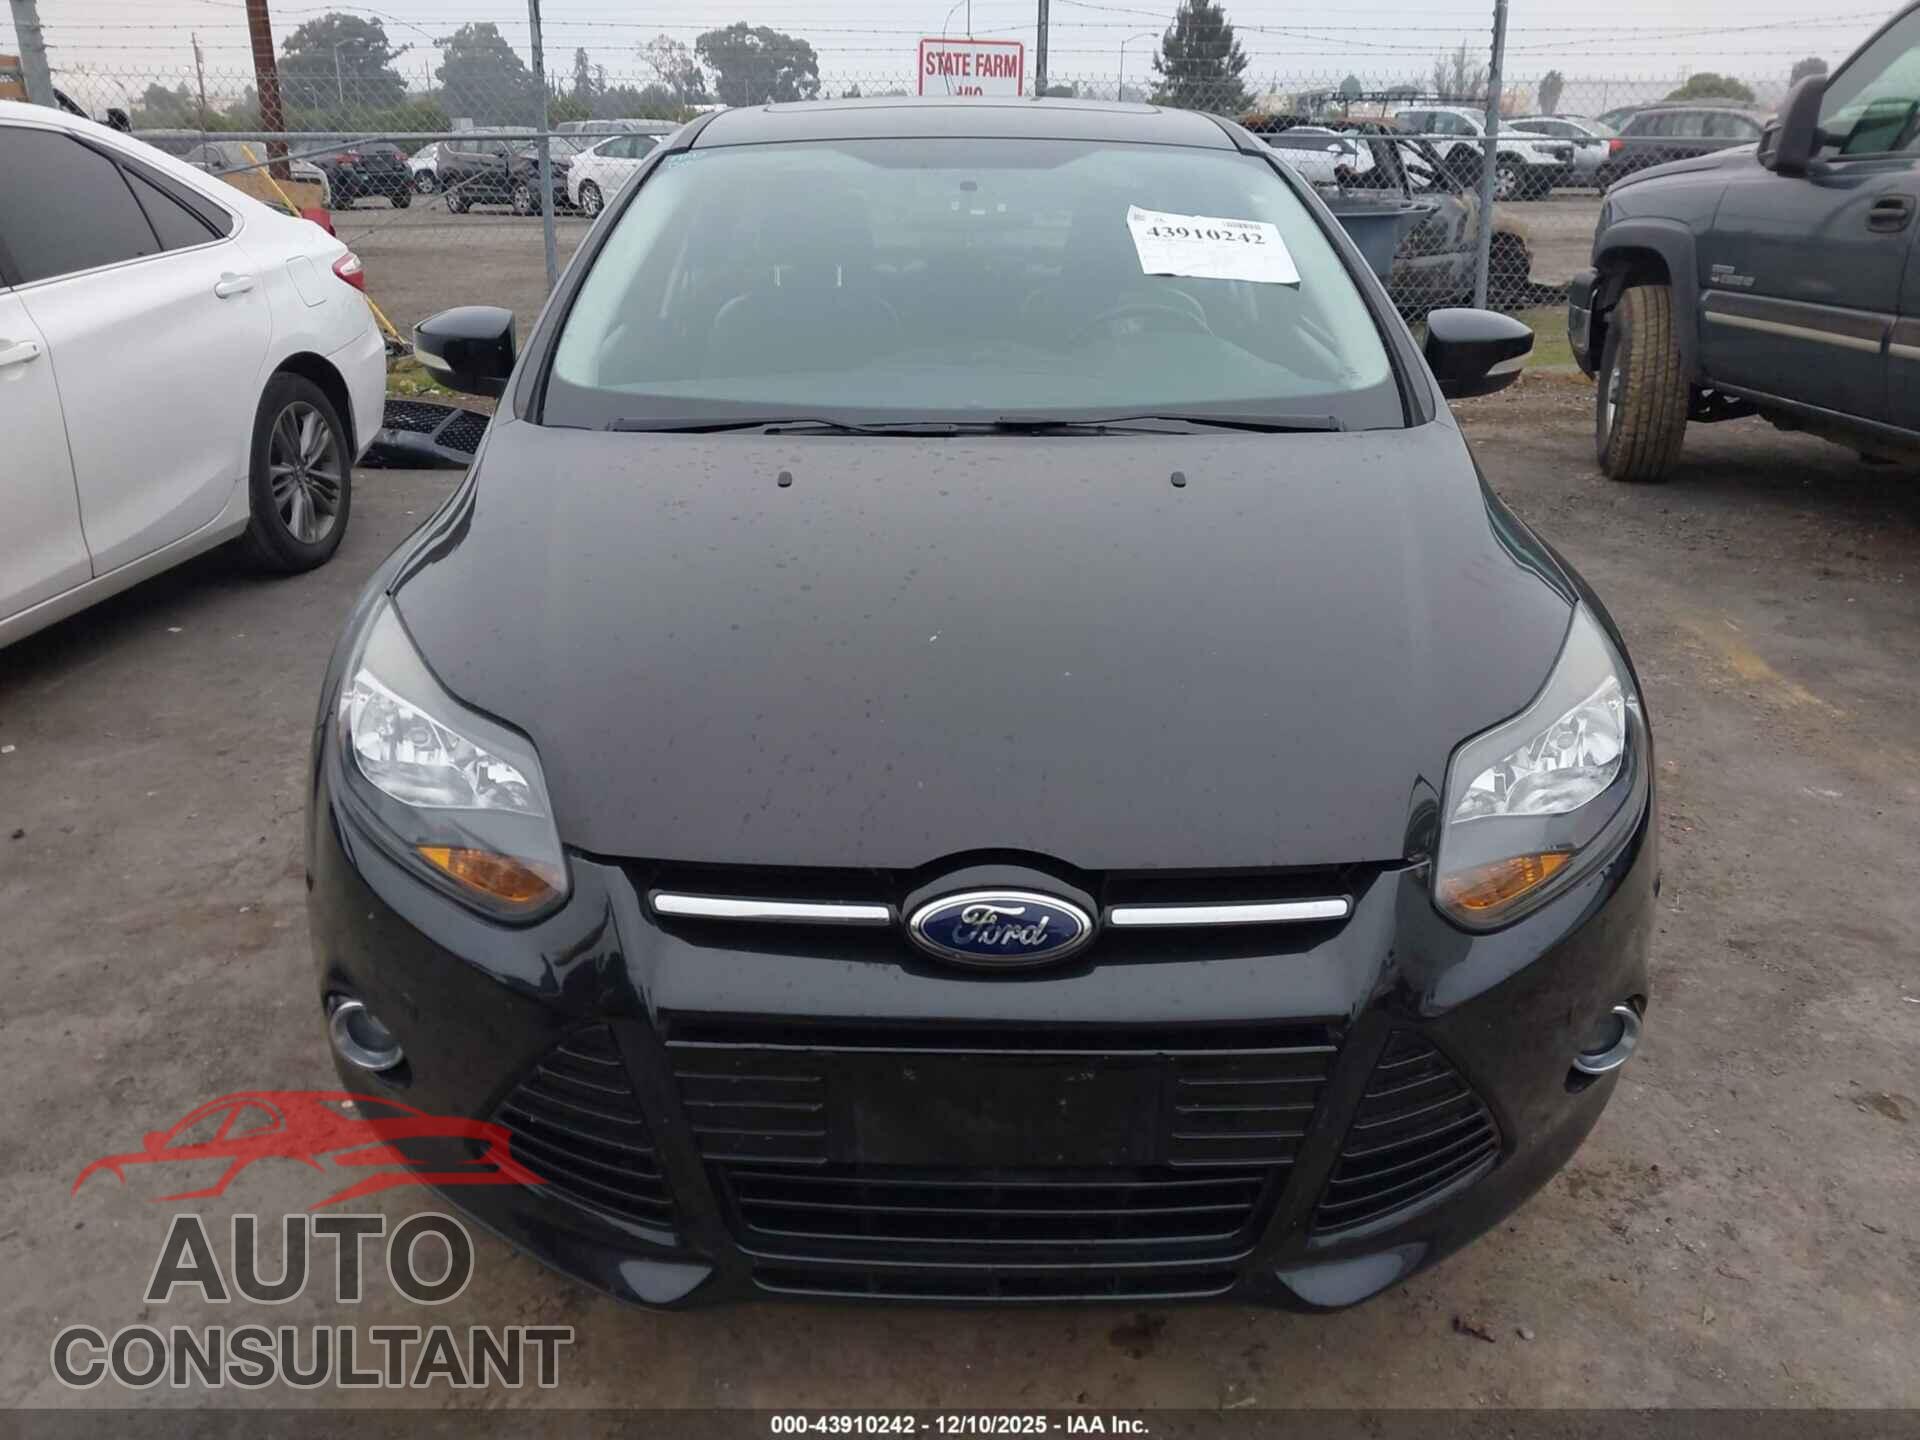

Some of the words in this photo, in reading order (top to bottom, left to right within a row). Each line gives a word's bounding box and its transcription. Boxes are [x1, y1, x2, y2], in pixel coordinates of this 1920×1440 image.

[925, 51, 971, 77] STATE
[975, 53, 1017, 78] FARM
[1147, 226, 1266, 245] 43910242
[951, 904, 1050, 945] Ford
